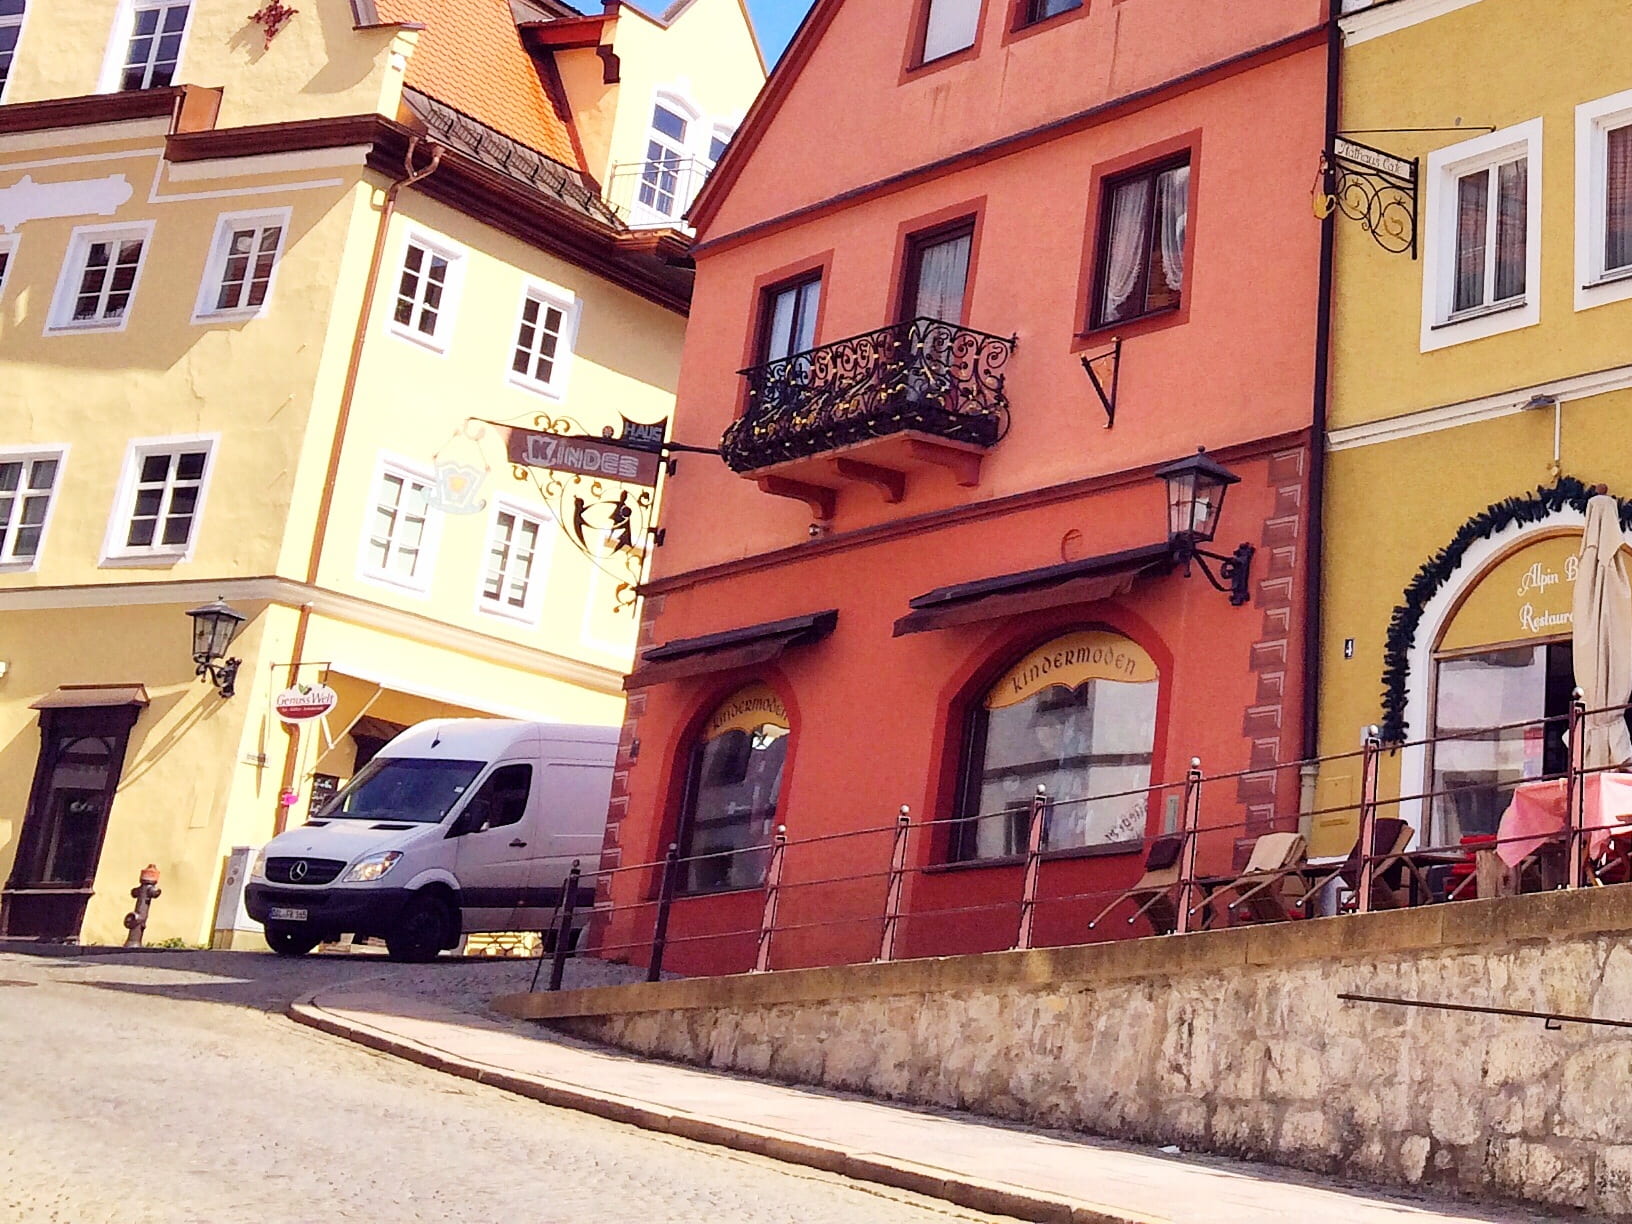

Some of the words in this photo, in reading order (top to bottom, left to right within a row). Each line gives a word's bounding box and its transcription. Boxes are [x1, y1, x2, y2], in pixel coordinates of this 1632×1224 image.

[624, 421, 663, 442] HAUS
[522, 435, 639, 478] KINDES
[1517, 562, 1559, 596] Alpin
[1345, 640, 1353, 657] 4
